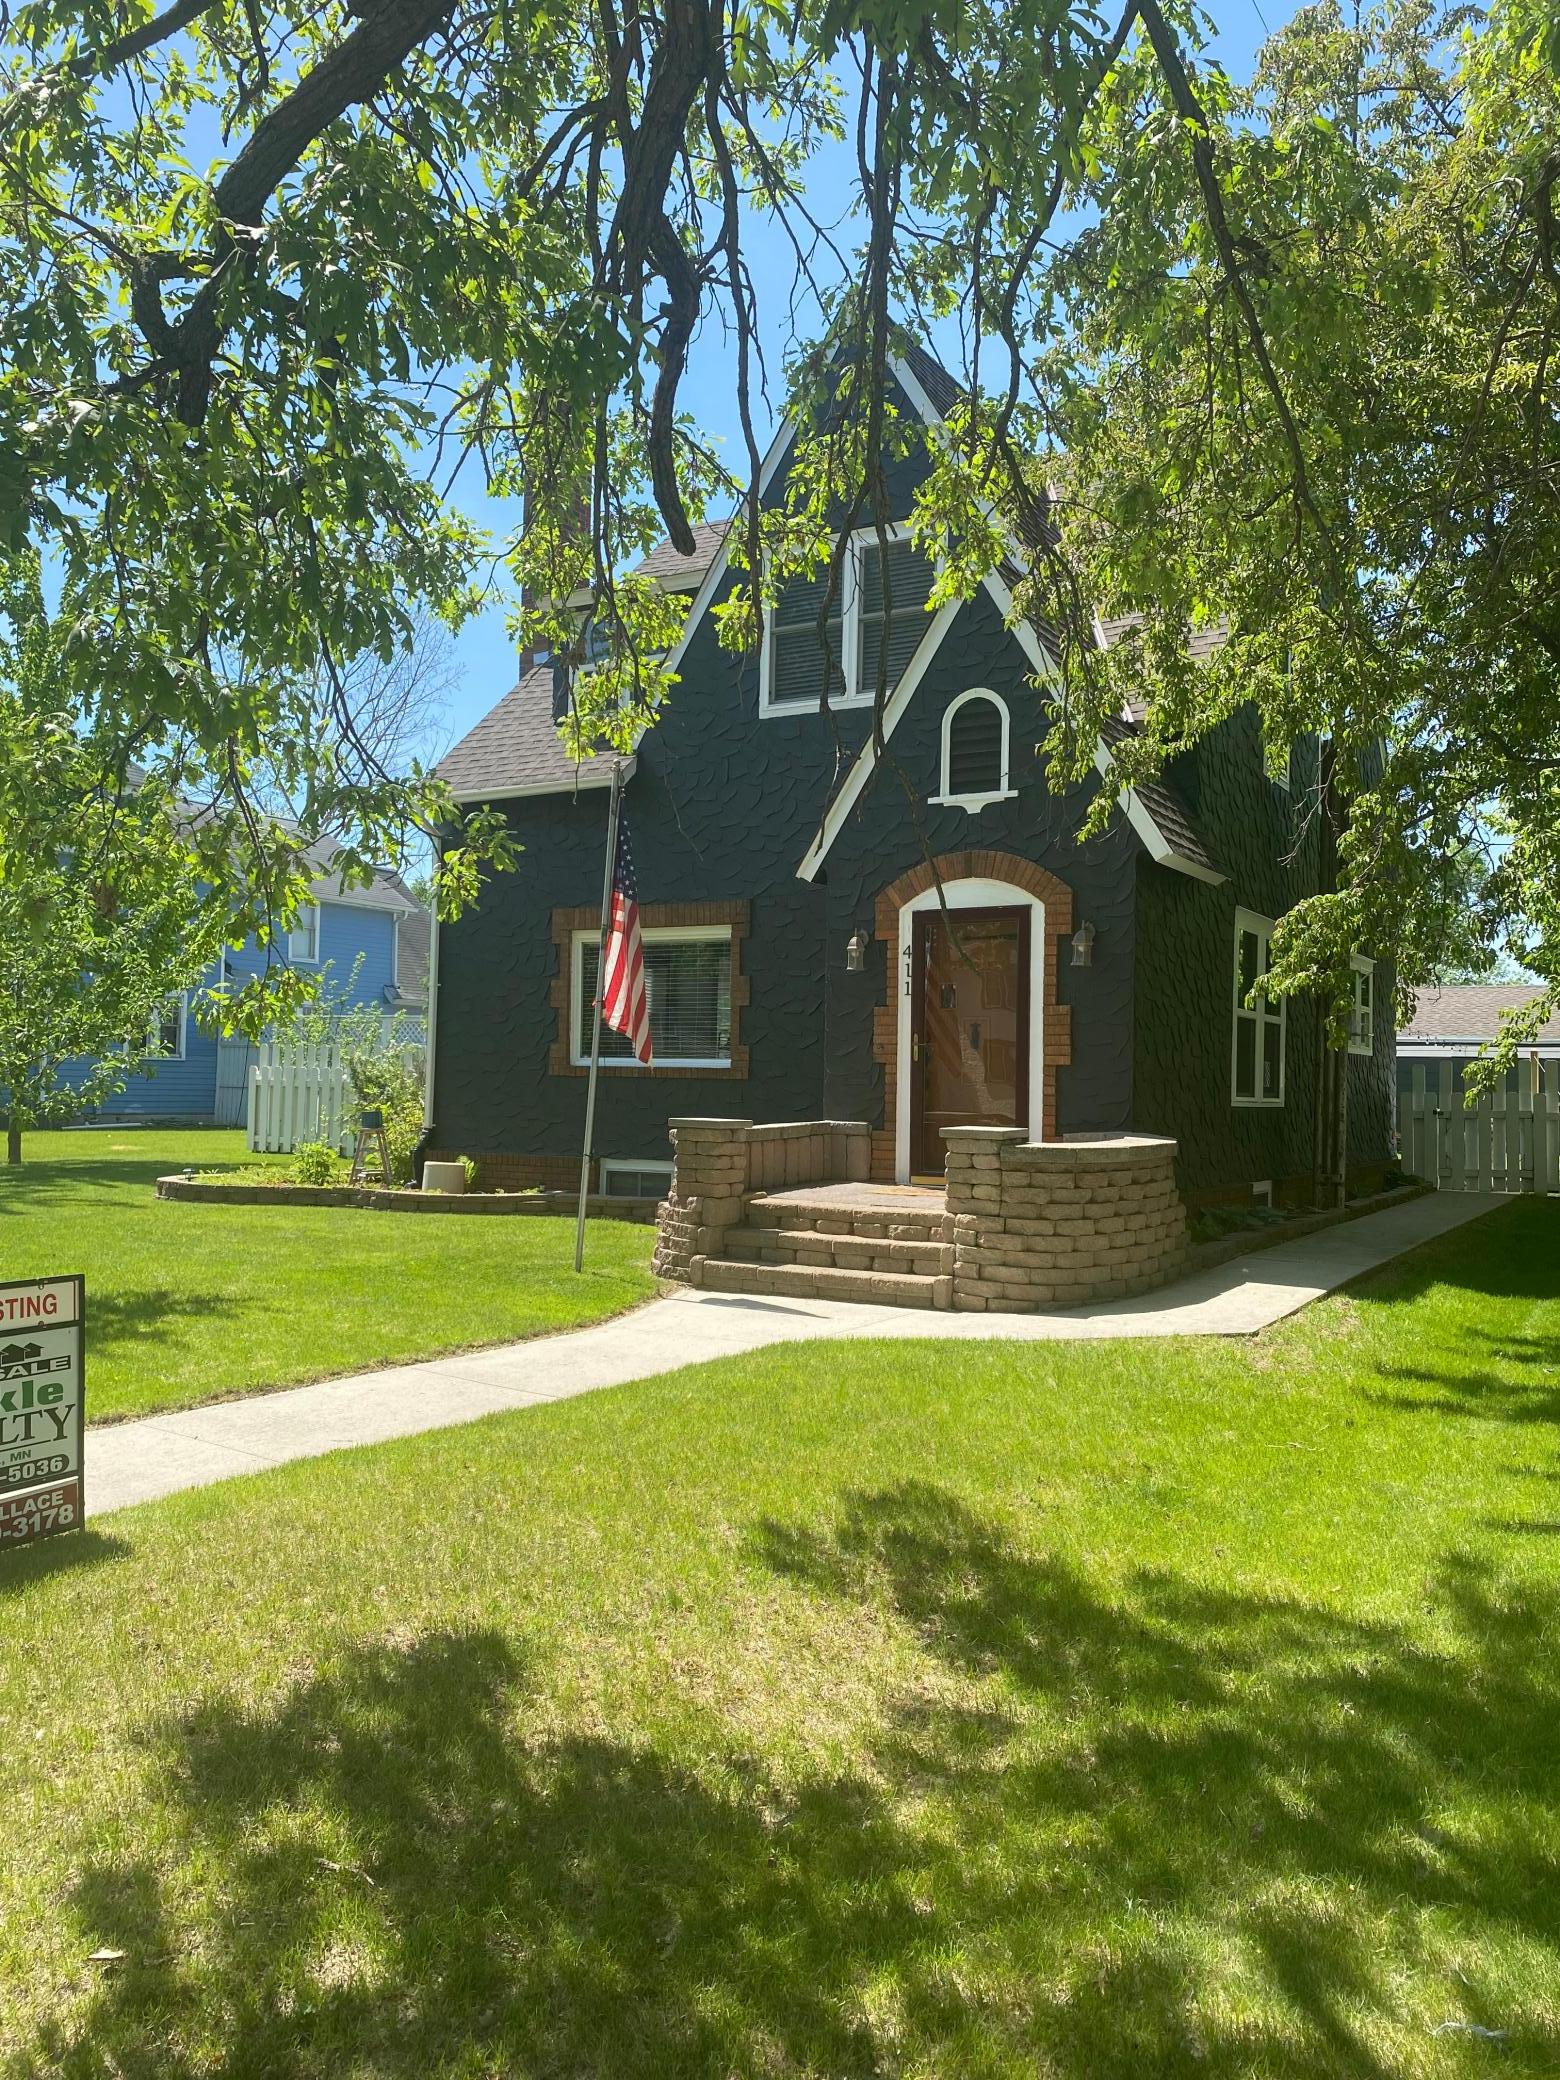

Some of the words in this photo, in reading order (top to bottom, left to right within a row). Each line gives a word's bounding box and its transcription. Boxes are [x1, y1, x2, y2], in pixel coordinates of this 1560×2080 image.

[903, 944, 913, 996] 411
[0, 1404, 76, 1445] LTY
[10, 1449, 31, 1462] MN
[0, 1504, 74, 1539] -3178
